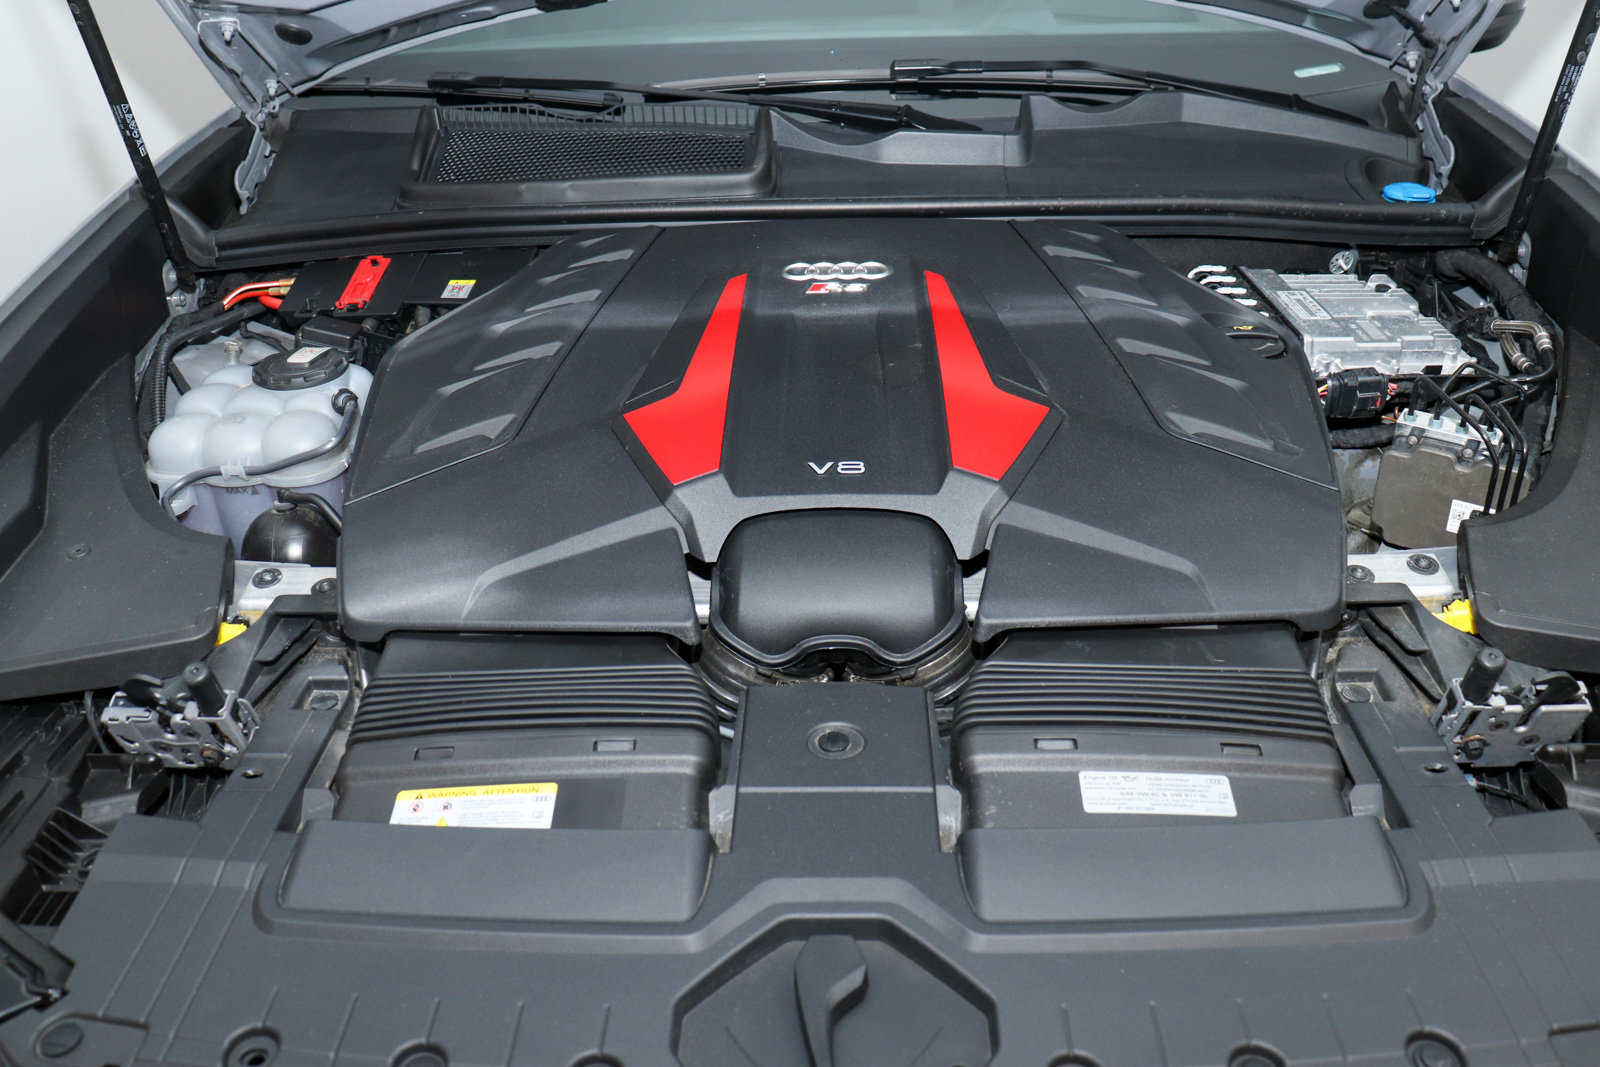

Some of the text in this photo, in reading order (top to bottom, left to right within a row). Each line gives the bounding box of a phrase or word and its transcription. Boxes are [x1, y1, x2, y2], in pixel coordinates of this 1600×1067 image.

[807, 461, 866, 475] V8
[427, 786, 540, 799] WARNING ATTENTION
